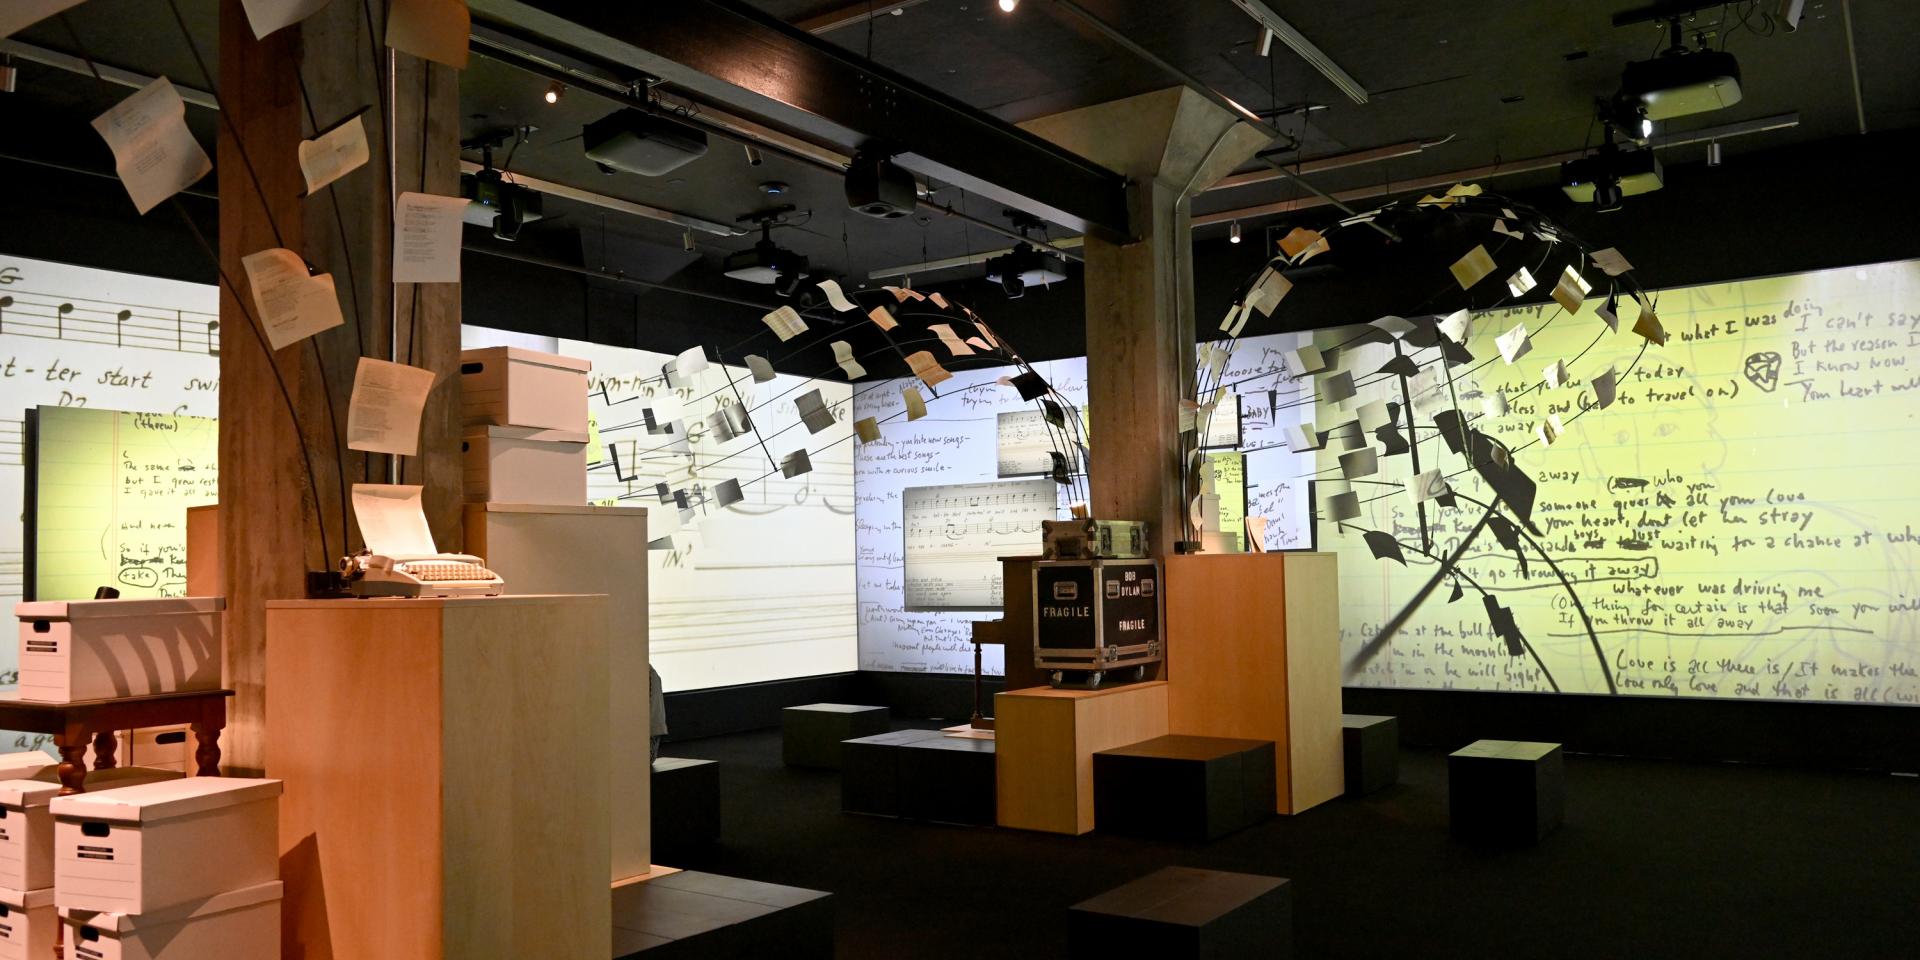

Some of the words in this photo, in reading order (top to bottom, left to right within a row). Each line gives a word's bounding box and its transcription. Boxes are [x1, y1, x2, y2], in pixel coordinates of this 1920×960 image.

[1681, 323, 1719, 342] what
[1725, 320, 1739, 335] I
[1745, 314, 1777, 327] was
[1795, 313, 1811, 332] I
[1826, 312, 1873, 330] can't
[1888, 312, 1920, 329] say
[1791, 341, 1817, 359] But
[1824, 339, 1845, 352] the
[98, 366, 152, 389] start
[1496, 381, 1527, 394] that
[1634, 364, 1685, 382] today
[1548, 400, 1570, 414] and
[1618, 391, 1635, 405] to
[1646, 385, 1694, 402] travel
[1498, 421, 1535, 434] away
[126, 476, 144, 485] but
[1539, 471, 1580, 484] away
[1759, 507, 1813, 531] stray
[1765, 536, 1776, 548] a
[1785, 533, 1841, 549] chance
[1854, 530, 1873, 547] at
[123, 570, 150, 580] take
[1124, 571, 1136, 582] BOB
[1489, 569, 1506, 584] go
[1585, 560, 1596, 579] it
[1608, 563, 1650, 578] away
[1121, 585, 1140, 597] DYLAN
[1698, 583, 1726, 595] was
[1733, 577, 1788, 602] driving
[1798, 586, 1824, 598] me
[1043, 606, 1090, 618] FRAGILE
[1592, 596, 1630, 615] thing
[1738, 602, 1747, 614] is
[1758, 600, 1789, 614] that
[1119, 619, 1145, 632] FRAGILE
[1434, 624, 1454, 637] the
[1559, 612, 1575, 628] If
[1613, 614, 1653, 627] throw
[1664, 614, 1676, 627] it
[1687, 617, 1705, 628] all
[1718, 618, 1753, 631] away
[1434, 643, 1454, 658] the
[1616, 649, 1653, 671] Love
[1663, 656, 1677, 673] is
[1688, 659, 1709, 674] all
[1716, 658, 1755, 675] there
[1831, 663, 1880, 678] makes
[1889, 662, 1919, 678] the
[1734, 682, 1760, 696] and
[1772, 680, 1810, 699] that
[1825, 683, 1838, 700] is
[1854, 687, 1878, 702] all
